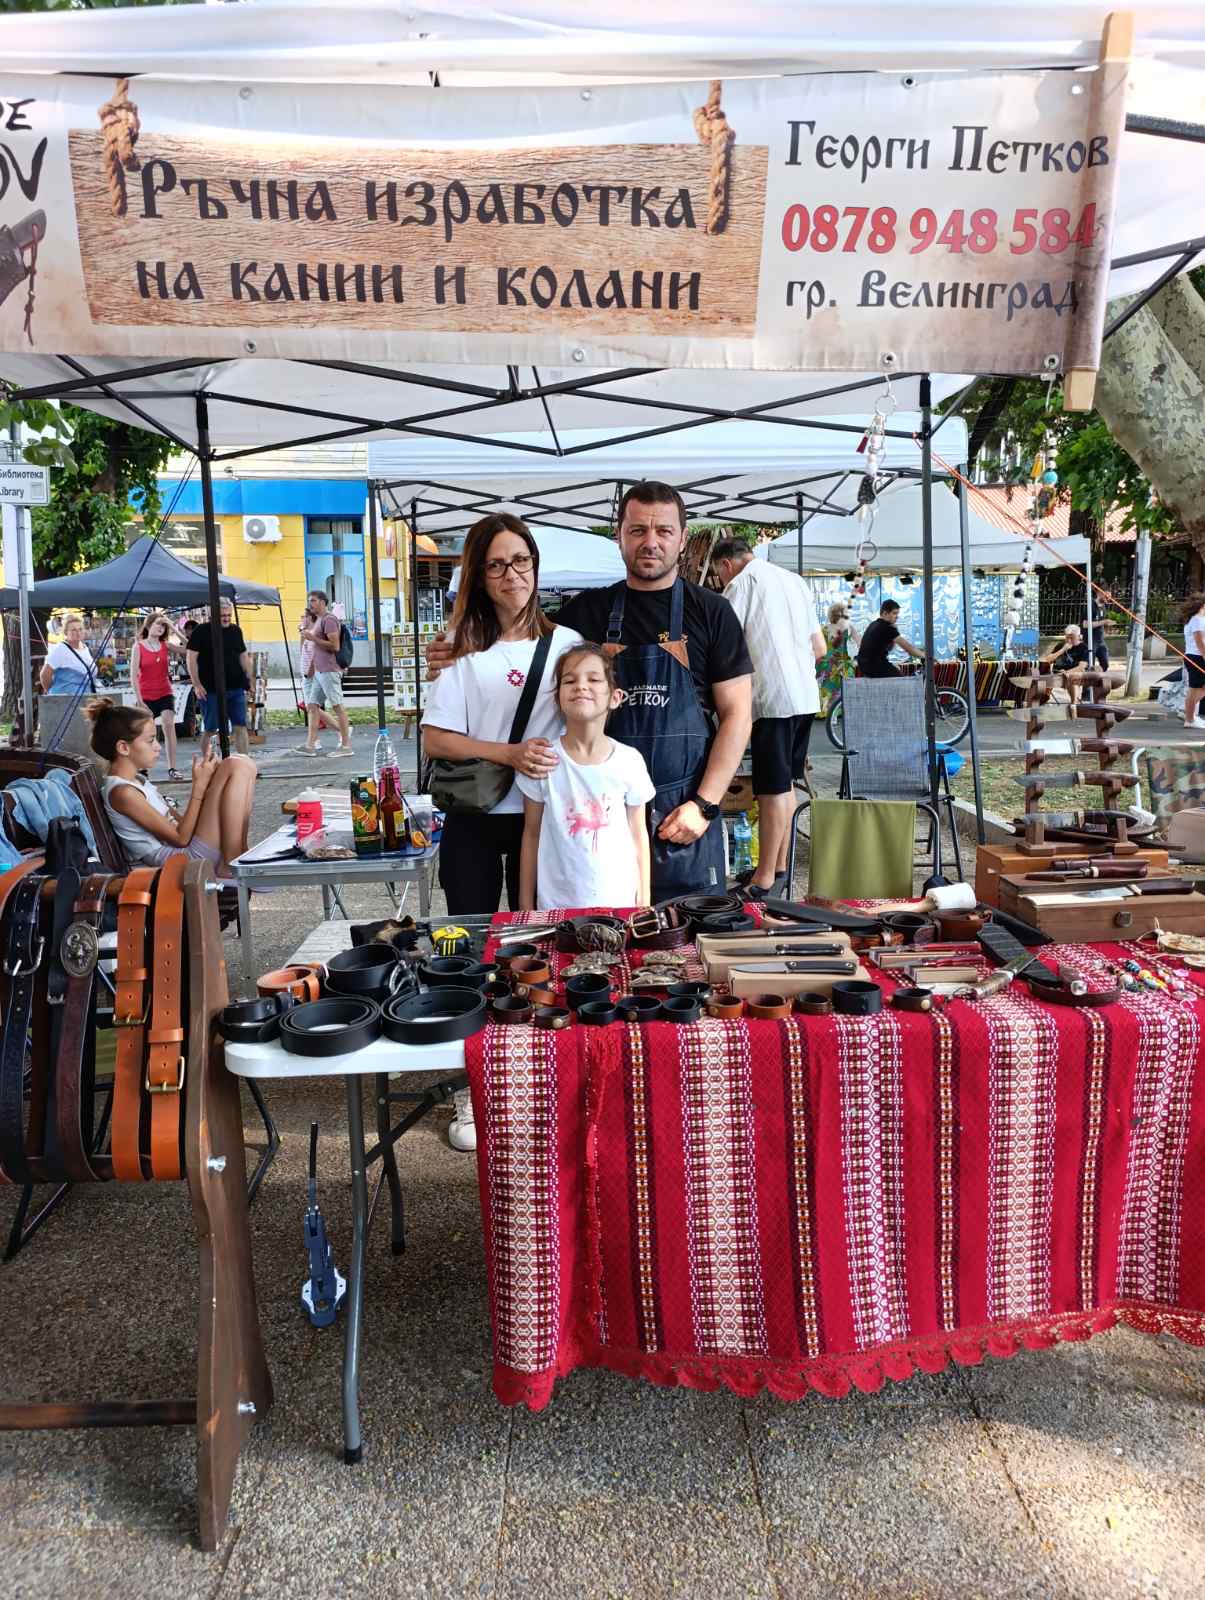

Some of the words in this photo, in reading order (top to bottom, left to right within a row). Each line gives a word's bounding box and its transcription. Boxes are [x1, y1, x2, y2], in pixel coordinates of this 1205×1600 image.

[0, 98, 36, 131] E
[0, 136, 48, 202] V
[785, 120, 931, 184] Георги
[948, 126, 1110, 174] Петков
[139, 159, 339, 221] Ръчна
[365, 179, 697, 243] изработка
[781, 203, 898, 255] 0878
[909, 207, 999, 255] 948
[1009, 202, 1098, 255] 584
[136, 260, 205, 300] на
[230, 262, 405, 303] кании
[434, 265, 467, 304] и
[497, 265, 701, 310] колани
[785, 279, 837, 321] гр.
[856, 269, 1080, 322] Велинград
[0, 487, 24, 499] ibrary
